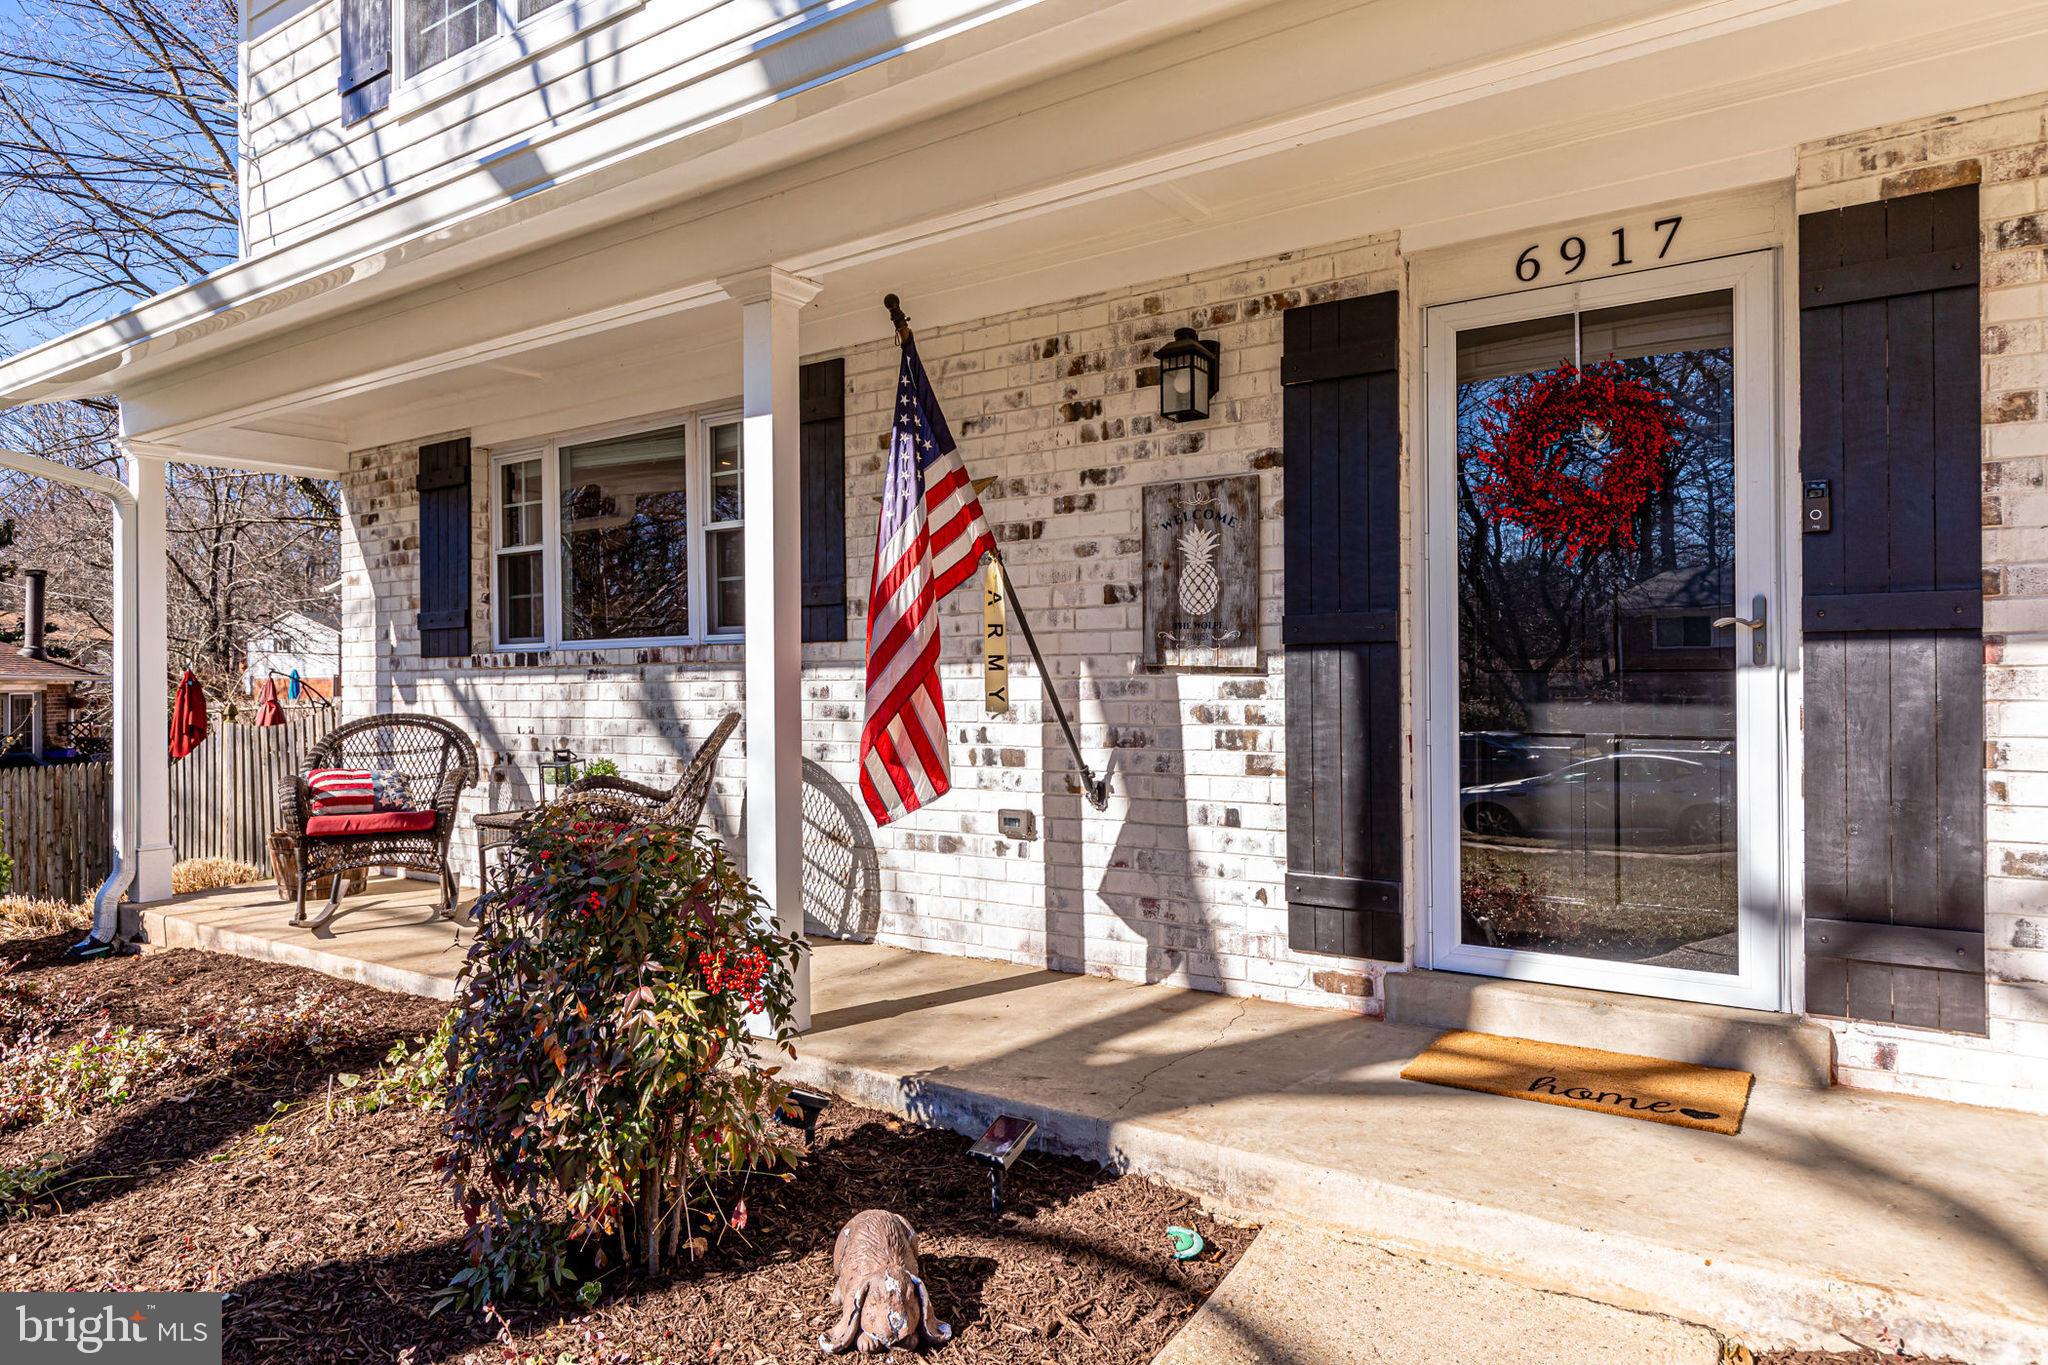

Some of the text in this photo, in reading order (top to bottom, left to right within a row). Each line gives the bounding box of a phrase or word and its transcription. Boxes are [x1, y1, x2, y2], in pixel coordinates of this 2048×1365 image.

[1515, 216, 1682, 282] 6917
[1161, 509, 1238, 531] WELCOME
[987, 590, 1006, 702] ARMY
[1527, 1076, 1677, 1114] home
